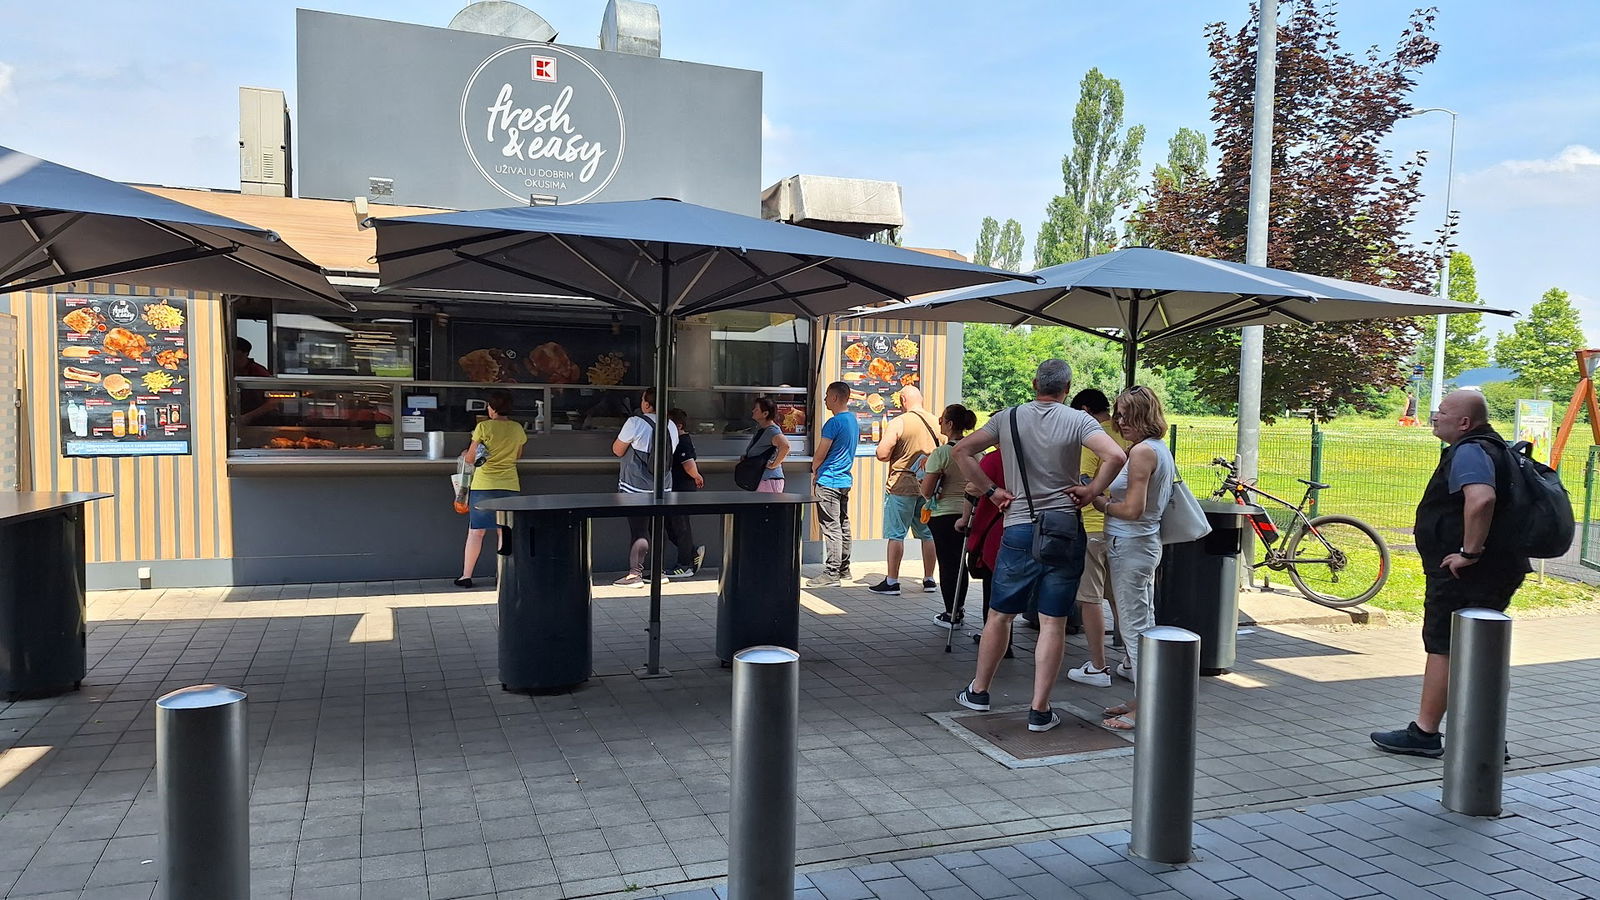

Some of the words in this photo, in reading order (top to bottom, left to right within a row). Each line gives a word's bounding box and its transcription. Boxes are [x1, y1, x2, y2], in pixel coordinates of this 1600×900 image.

[487, 83, 575, 142] fresh
[495, 164, 527, 176] UŽIVAJ
[528, 169, 536, 178] U
[538, 169, 574, 179] DOBRIM
[524, 178, 567, 190] OKUSIMA
